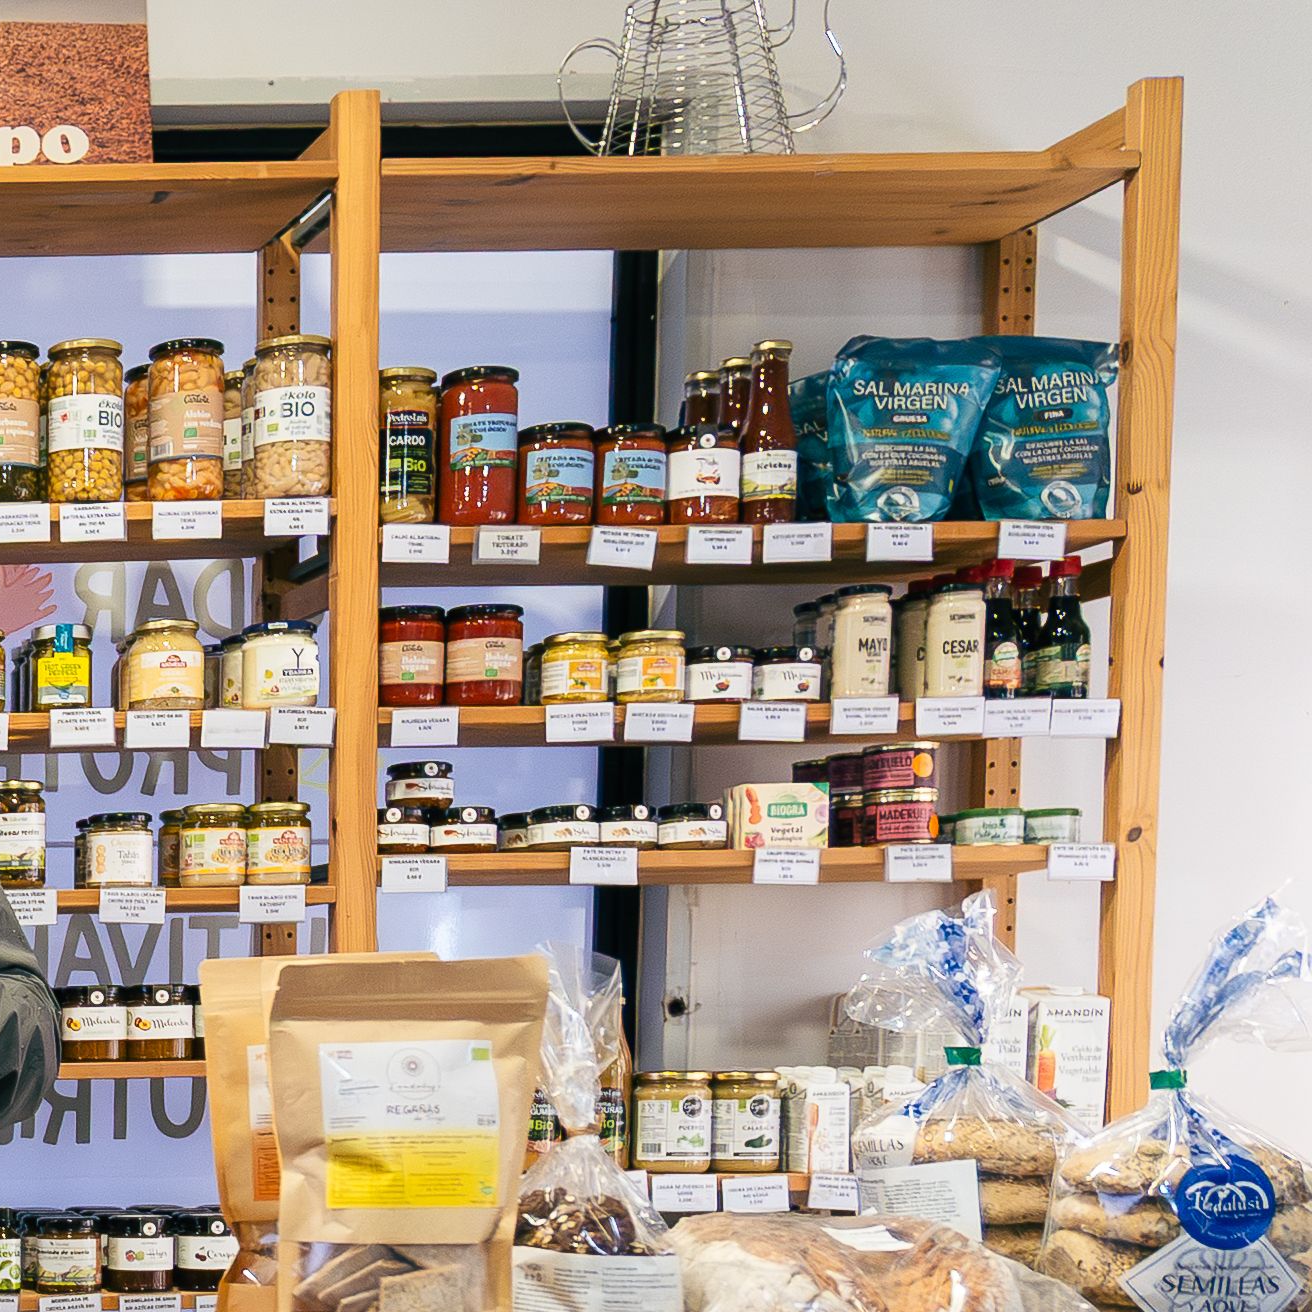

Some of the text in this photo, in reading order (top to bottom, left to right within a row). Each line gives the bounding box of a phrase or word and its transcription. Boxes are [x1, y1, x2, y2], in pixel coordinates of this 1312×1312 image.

[853, 380, 970, 397] SAL MARINA
[994, 377, 1029, 396] SAL
[875, 396, 948, 411] VIRGEN
[1015, 386, 1089, 409] VIRGEN
[280, 402, 316, 418] BIO
[98, 410, 124, 428] BIO
[389, 435, 426, 447] CARDO
[943, 640, 980, 654] CESAR
[770, 826, 804, 835] Vegetal
[1161, 1273, 1281, 1296] SEMILLAS
